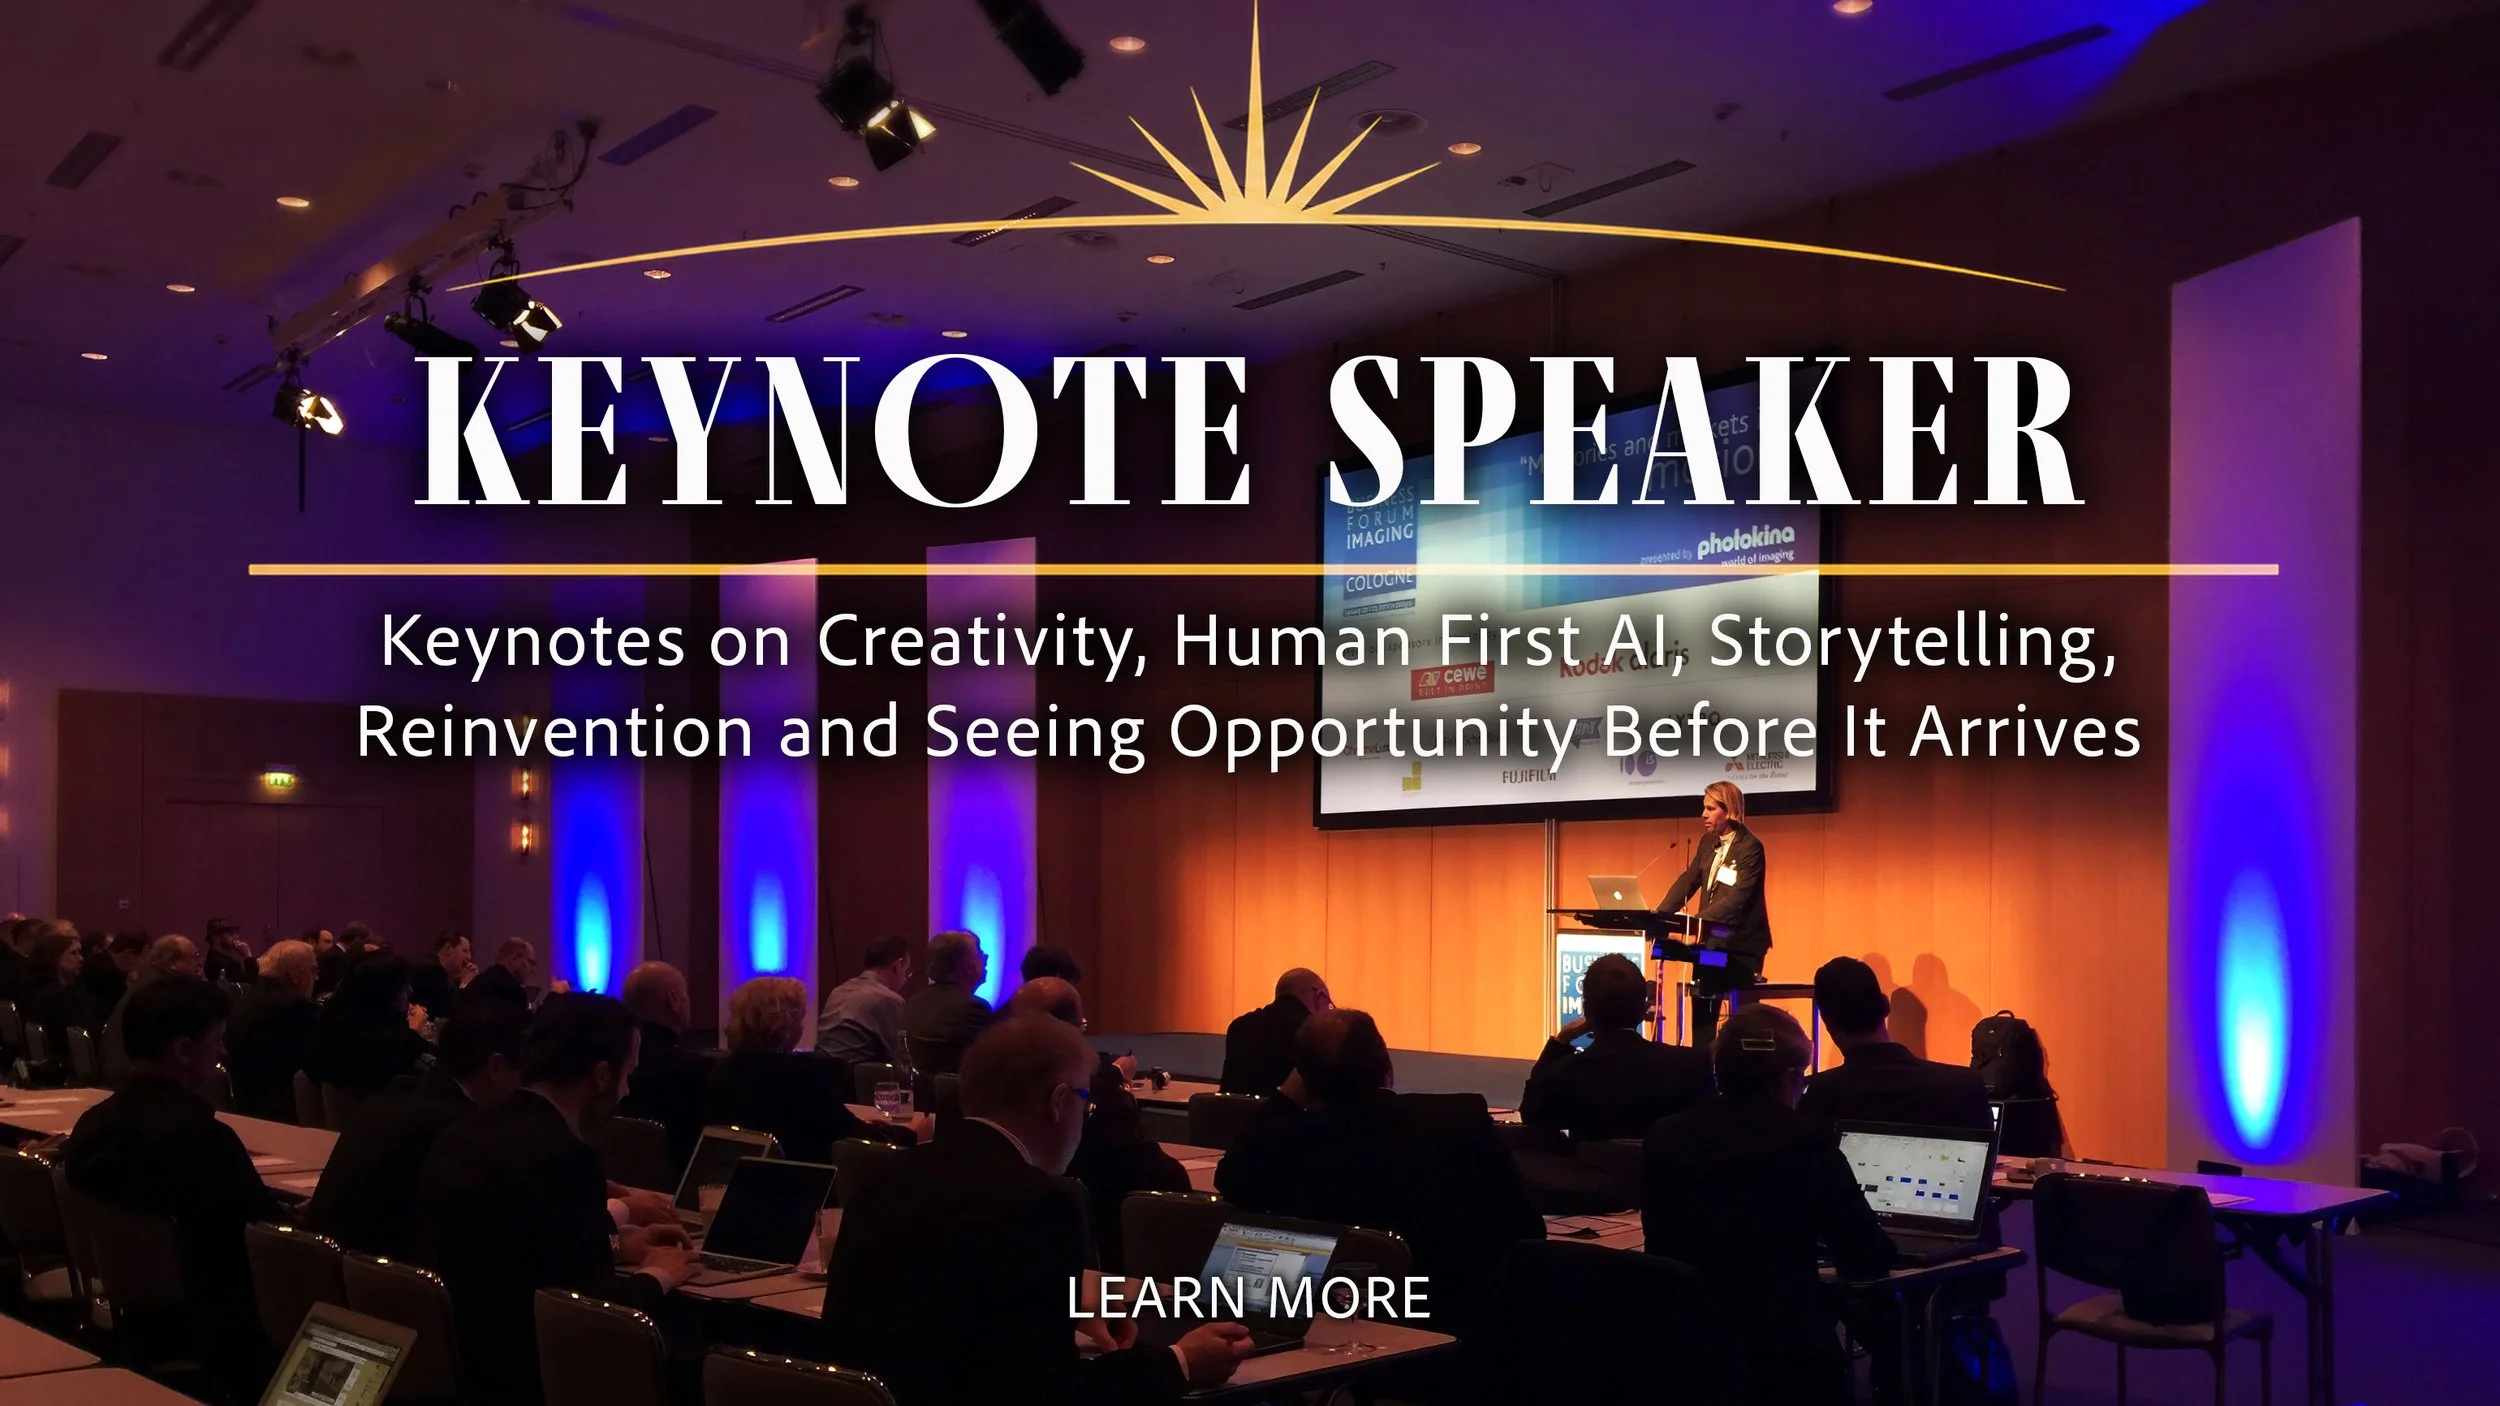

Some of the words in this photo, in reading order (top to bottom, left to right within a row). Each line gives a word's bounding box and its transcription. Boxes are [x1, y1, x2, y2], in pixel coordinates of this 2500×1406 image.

[1347, 505, 1414, 532] FORUM
[1346, 523, 1414, 550] IMAGING
[1697, 524, 1795, 561] photokina
[1346, 567, 1414, 592] COLOGNE
[1444, 666, 1486, 684] cewe
[1560, 652, 1624, 679] Kodak
